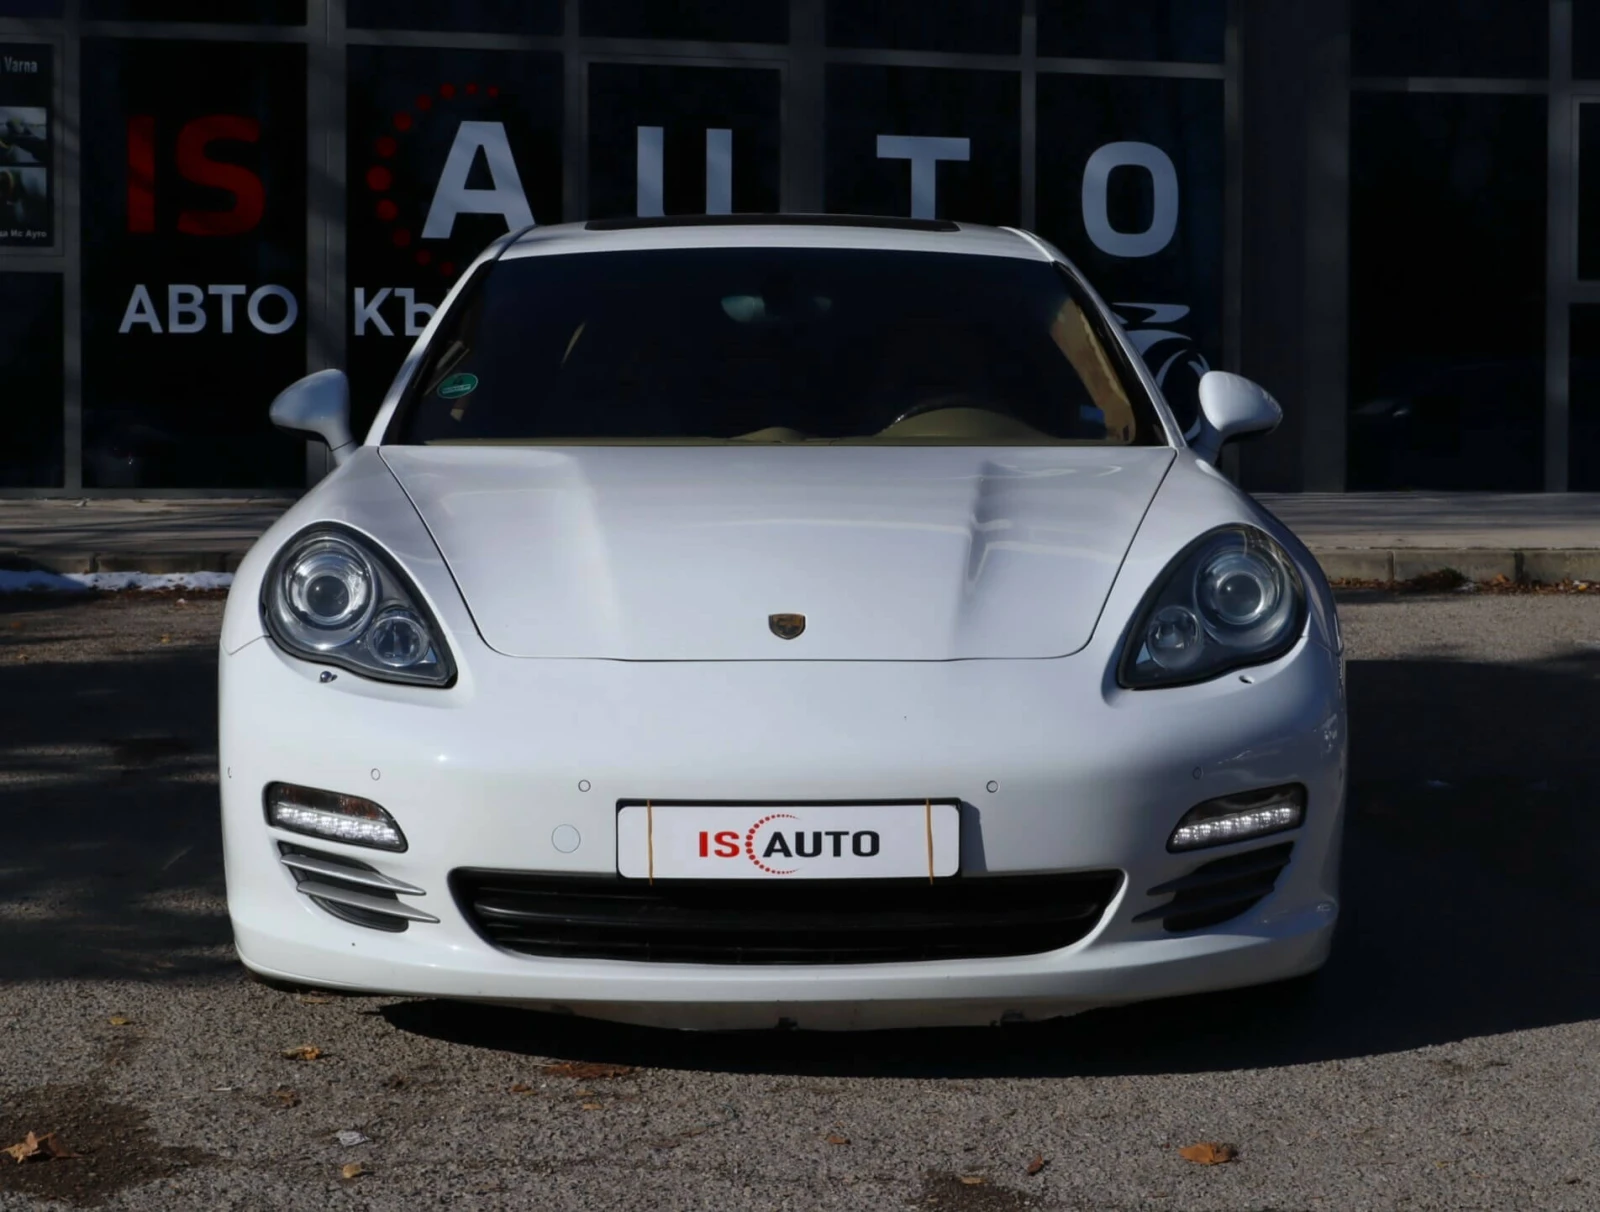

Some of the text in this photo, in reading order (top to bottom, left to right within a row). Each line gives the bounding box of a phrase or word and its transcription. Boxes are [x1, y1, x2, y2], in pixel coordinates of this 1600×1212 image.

[4, 56, 38, 73] Varna
[127, 114, 266, 236] IS
[118, 284, 452, 337] АВТО КЪ
[699, 830, 880, 858] IS AUTO
